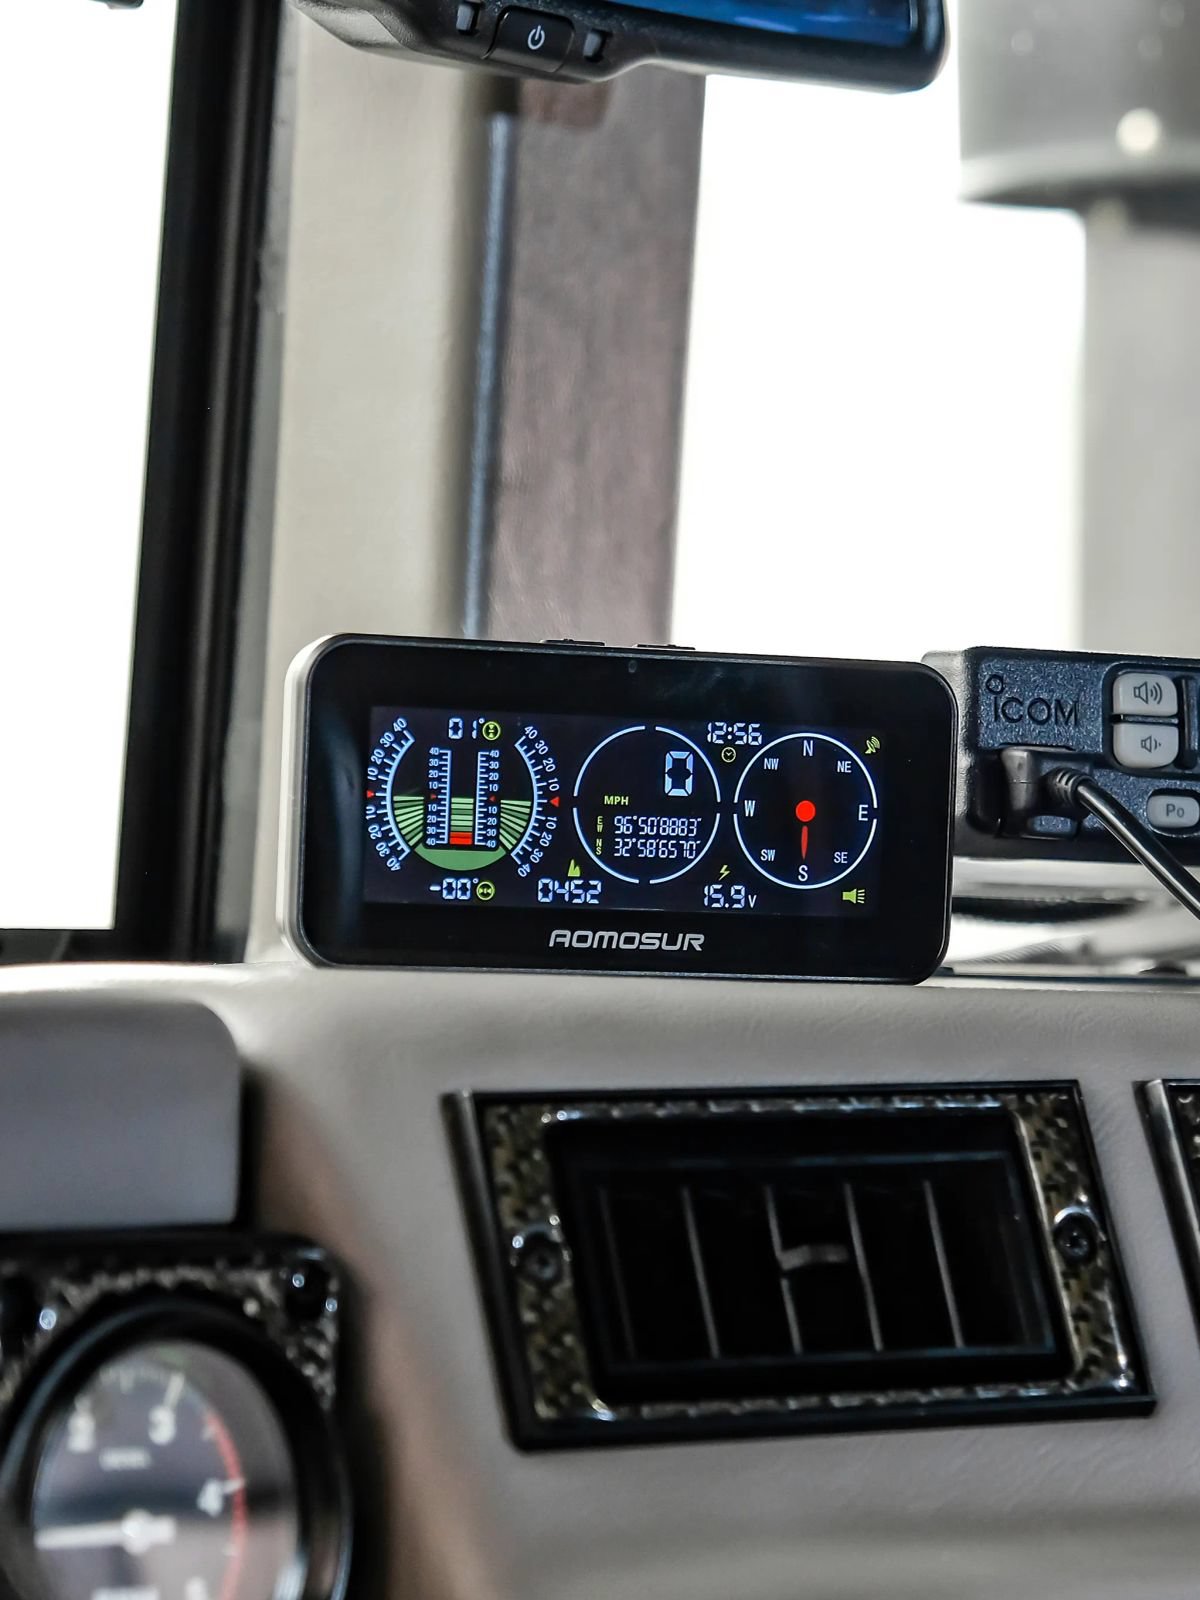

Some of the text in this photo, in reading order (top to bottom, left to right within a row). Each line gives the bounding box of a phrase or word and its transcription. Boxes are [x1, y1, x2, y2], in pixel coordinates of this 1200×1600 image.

[393, 717, 407, 732] 40
[379, 732, 395, 747] 30
[524, 725, 538, 740] 40
[707, 721, 763, 746] 12:56
[489, 750, 500, 758] 40
[535, 740, 549, 755] 30
[803, 740, 814, 757] N
[370, 749, 385, 764] 20
[764, 758, 779, 770] NW
[543, 758, 556, 772] 20
[837, 761, 852, 773] NE
[367, 768, 379, 780] 10
[428, 770, 439, 778] 20
[664, 750, 694, 797] 0
[548, 777, 560, 791] 10
[604, 795, 629, 806] MPH
[744, 800, 756, 816] W
[365, 806, 376, 820] 10
[859, 805, 868, 821] E
[546, 816, 558, 830] 10
[367, 825, 382, 840] 20
[539, 832, 553, 847] 20
[375, 842, 390, 857] 30
[530, 848, 543, 864] 30
[760, 849, 775, 861] SW
[386, 857, 402, 871] 40
[834, 851, 848, 864] SE
[517, 863, 531, 878] 40
[798, 864, 808, 881] S
[538, 878, 602, 904] 0452
[549, 929, 705, 952] AOMOSUR
